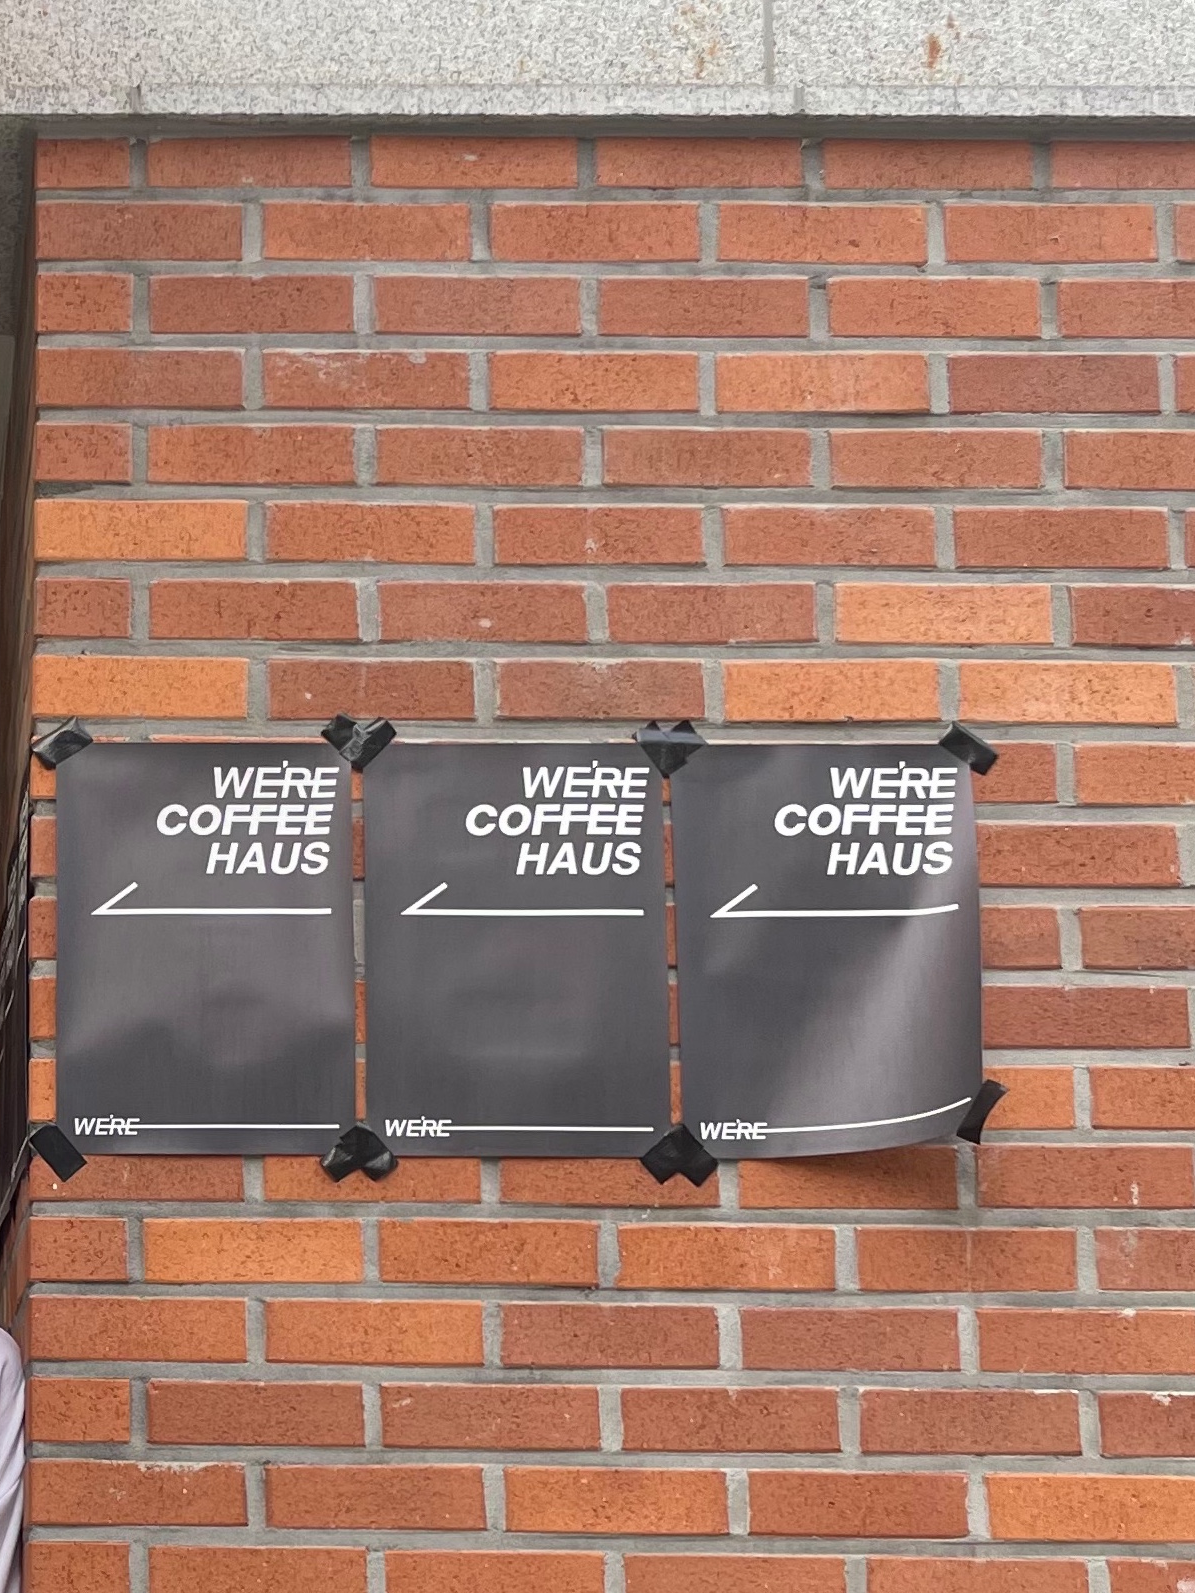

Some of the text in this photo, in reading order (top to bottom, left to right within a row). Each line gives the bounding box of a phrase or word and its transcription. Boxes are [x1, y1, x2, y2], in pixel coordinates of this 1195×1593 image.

[156, 803, 334, 836] COFFEE
[465, 803, 645, 837] COFFEE
[774, 803, 955, 837] COFFEE
[205, 841, 331, 875] HAUS
[515, 841, 642, 876] HAUS
[826, 840, 954, 876] HAUS
